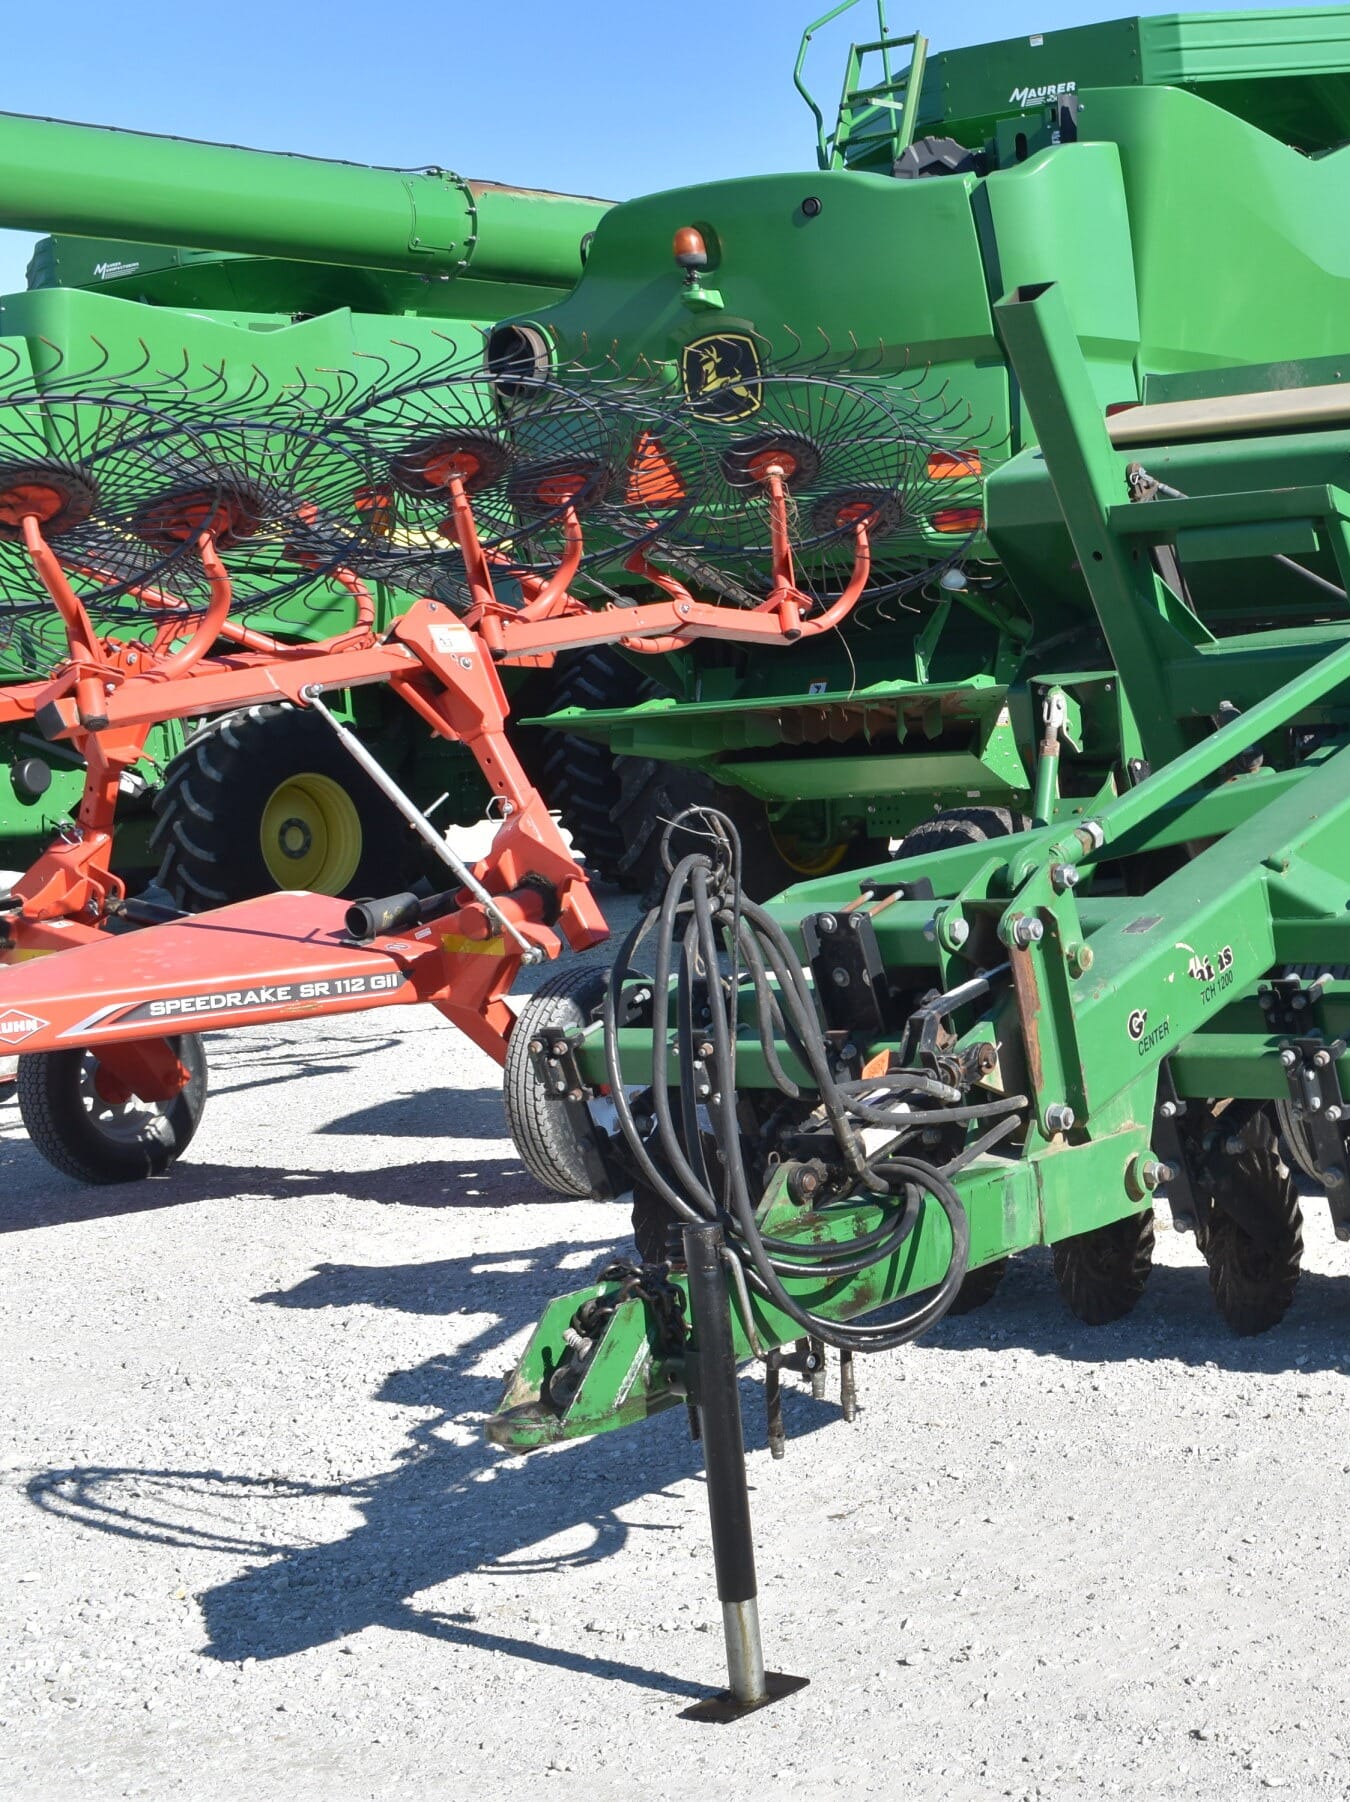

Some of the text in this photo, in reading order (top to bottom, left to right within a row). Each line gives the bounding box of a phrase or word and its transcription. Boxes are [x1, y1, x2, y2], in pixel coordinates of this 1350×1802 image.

[1009, 81, 1076, 107] MAURER
[150, 986, 292, 1016] SPEEDRAKE
[300, 981, 330, 999] SR
[335, 977, 366, 994] 112
[1138, 1020, 1170, 1056] CENTER
[1217, 969, 1233, 993] 1200
